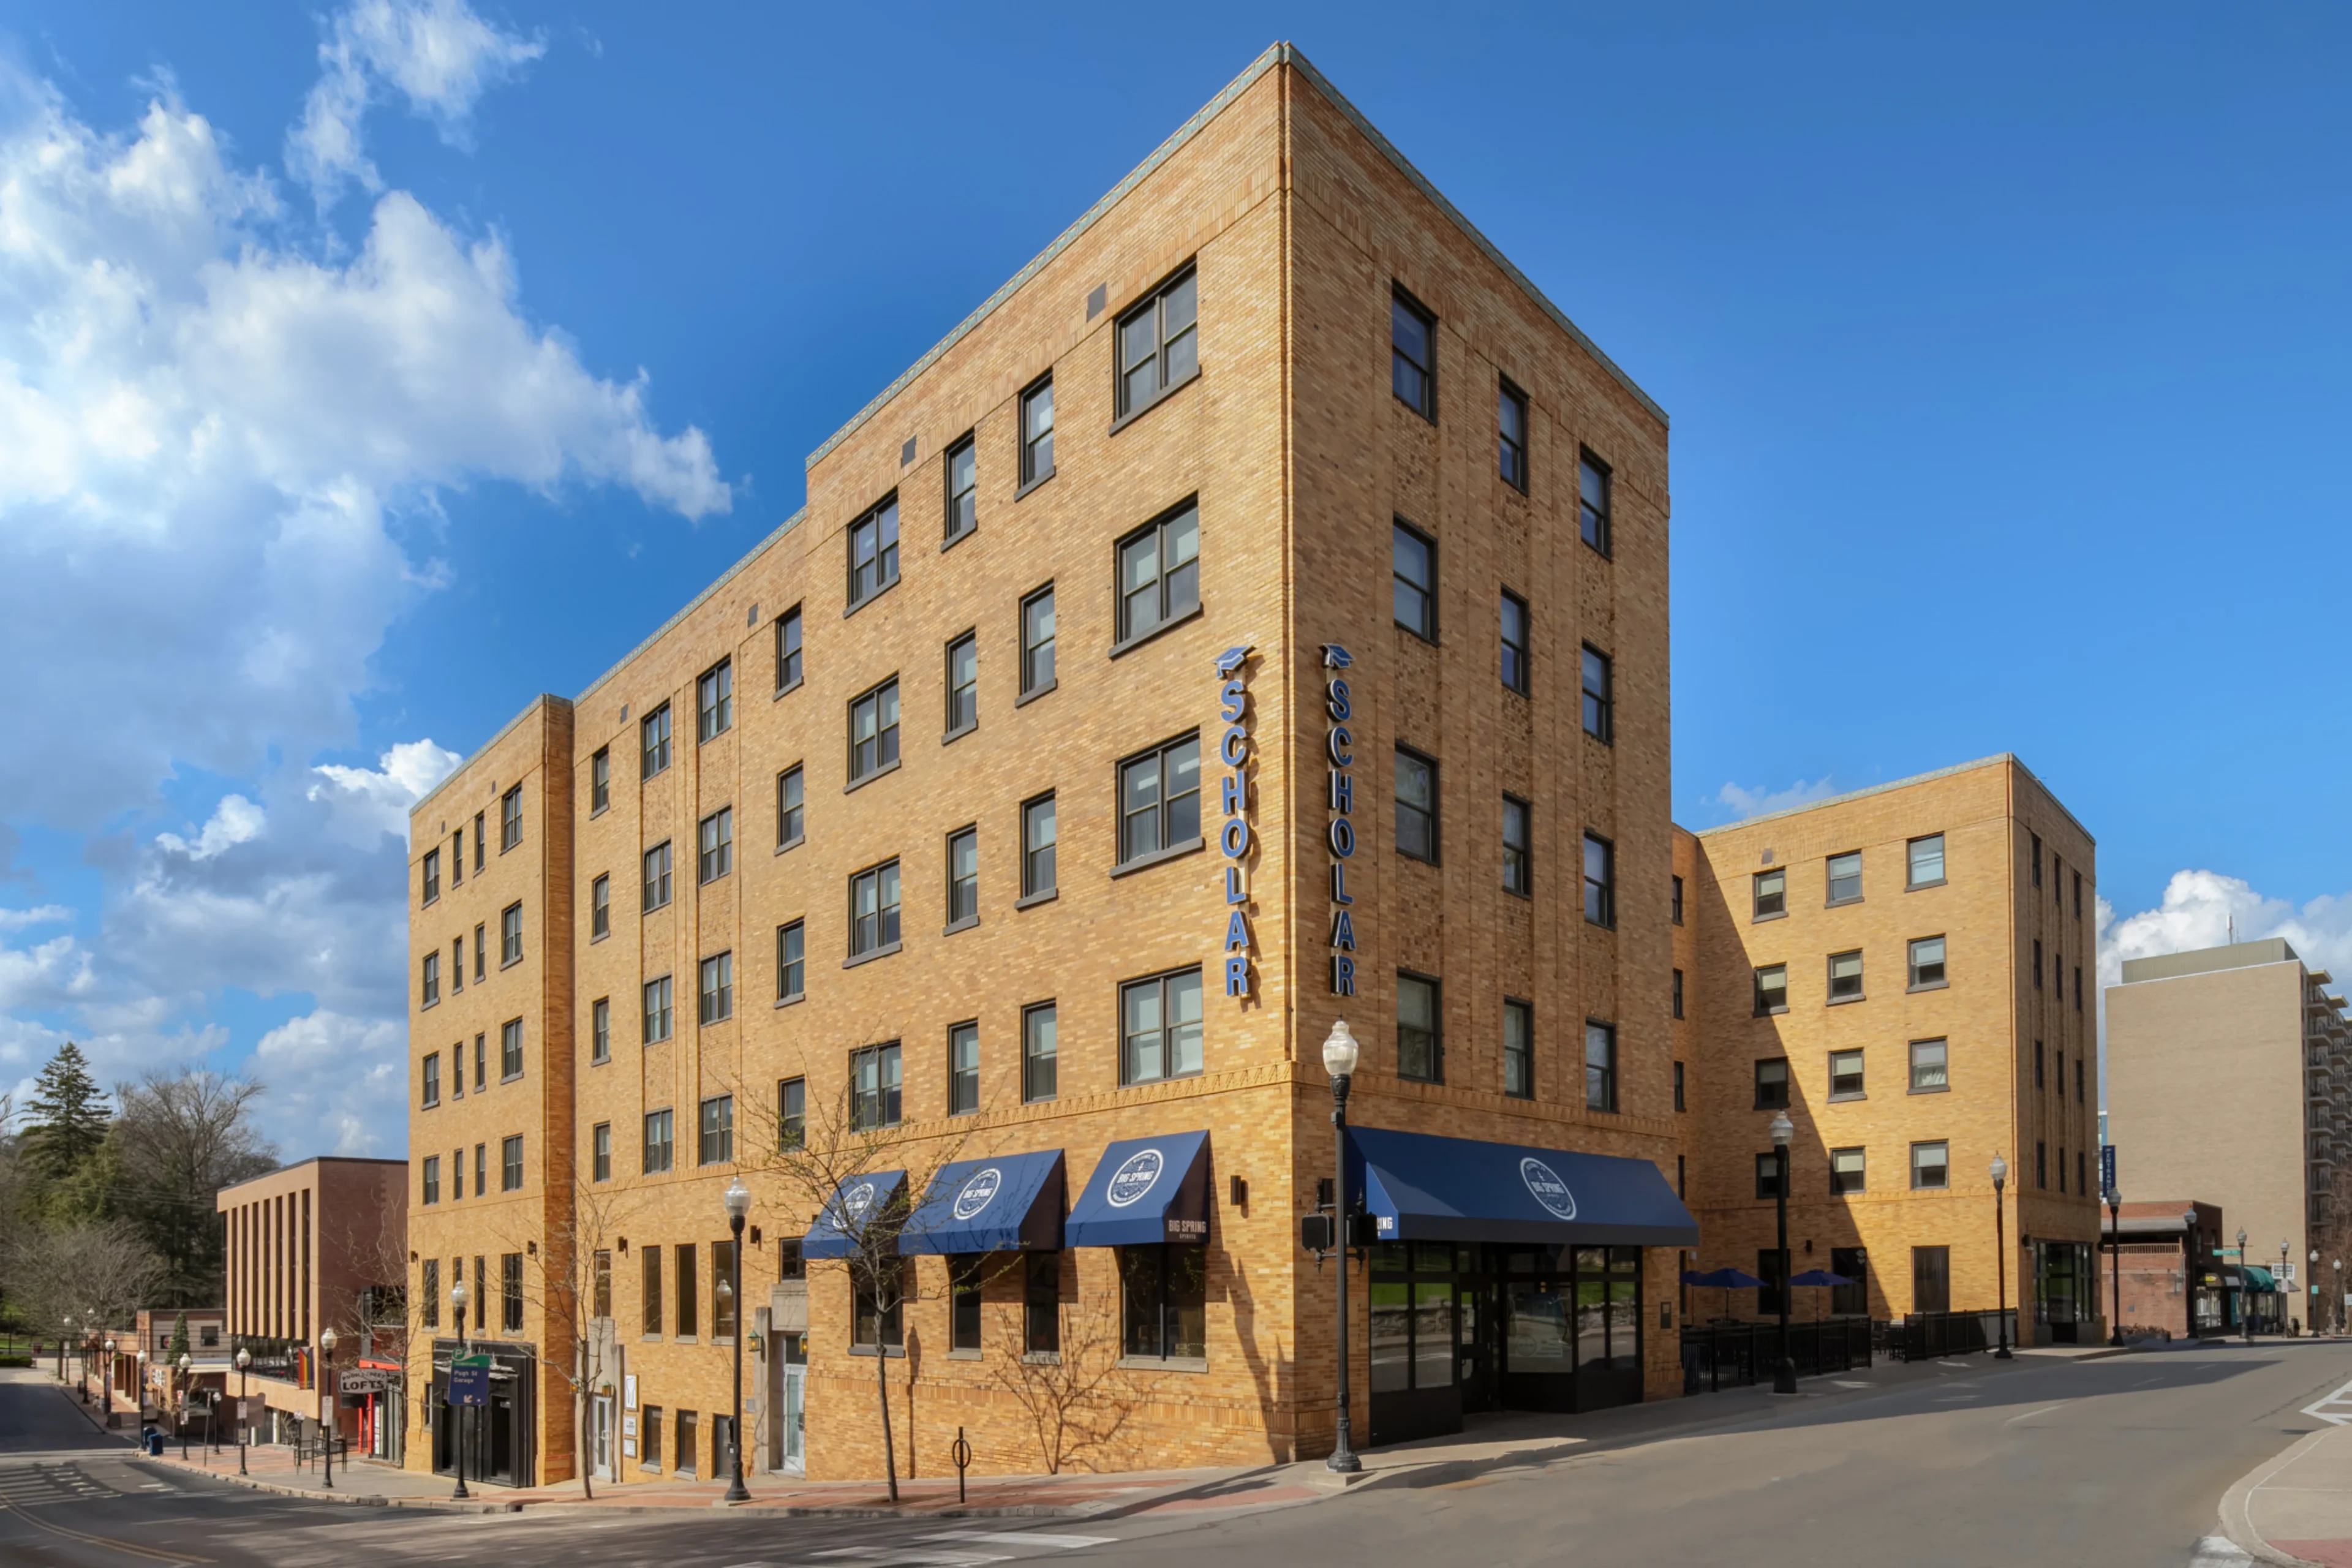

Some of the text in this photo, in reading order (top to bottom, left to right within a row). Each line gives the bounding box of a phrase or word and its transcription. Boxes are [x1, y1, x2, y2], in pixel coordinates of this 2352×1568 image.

[1220, 680, 1251, 997] SCHOLAR
[1326, 679, 1356, 997] SCHOLAR
[1117, 1170, 1155, 1183] BIG SPRING
[1169, 1220, 1206, 1233] BIG SPRING
[455, 1349, 462, 1357] P
[343, 1380, 385, 1391] LOFTS
